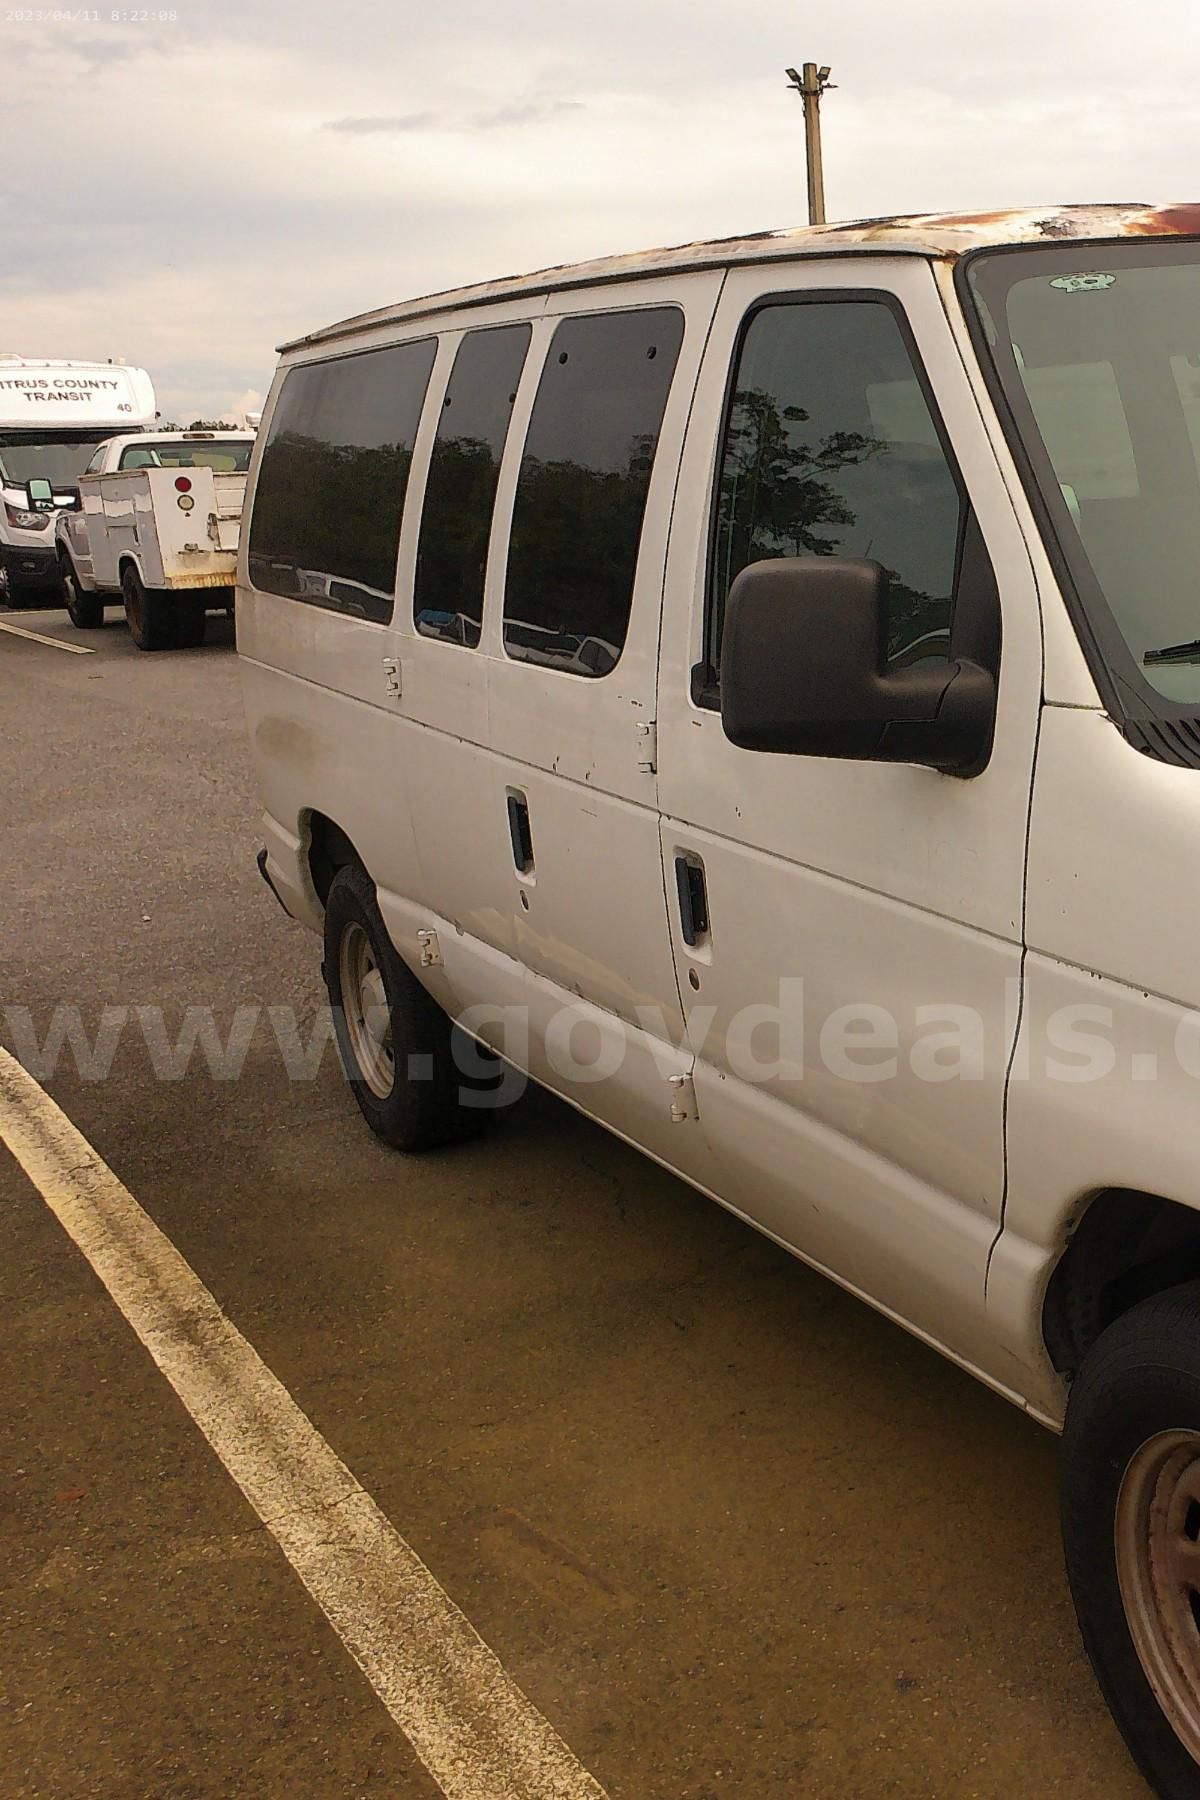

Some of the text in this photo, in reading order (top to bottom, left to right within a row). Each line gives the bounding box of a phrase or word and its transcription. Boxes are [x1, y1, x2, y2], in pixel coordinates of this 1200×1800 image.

[53, 379, 118, 390] COUNTY
[24, 392, 92, 401] TRANSIT
[117, 403, 132, 412] 40
